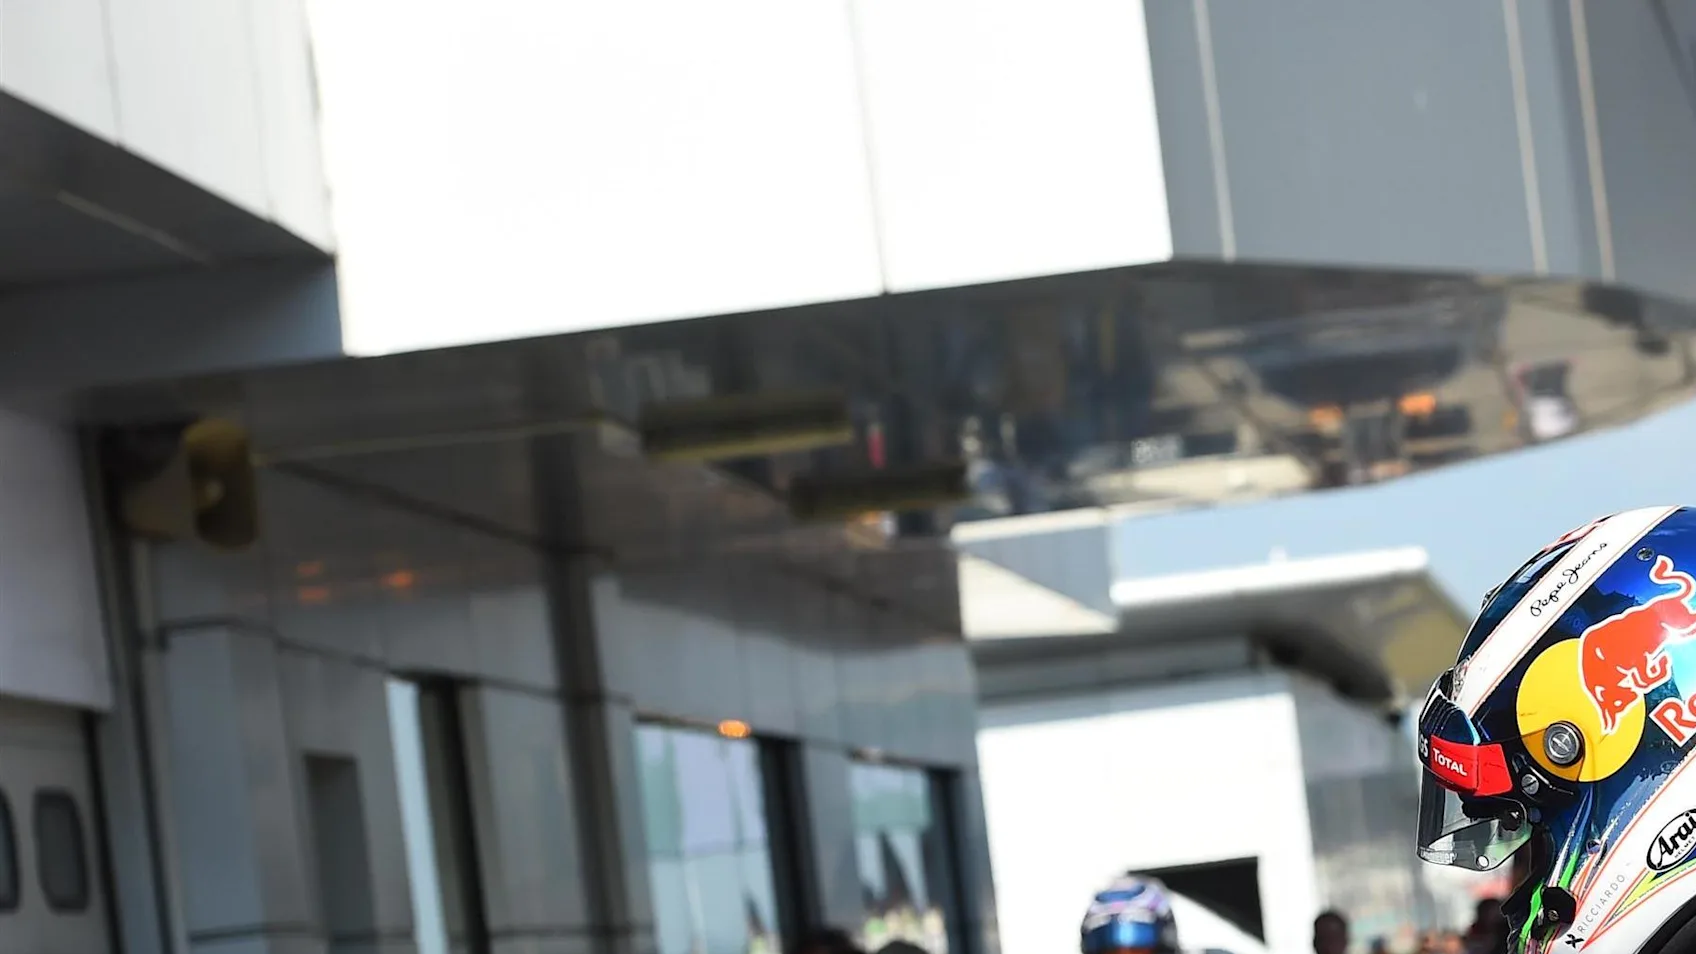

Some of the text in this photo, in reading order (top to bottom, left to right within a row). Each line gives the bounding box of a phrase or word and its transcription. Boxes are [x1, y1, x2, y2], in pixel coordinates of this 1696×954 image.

[1529, 542, 1608, 617] Pepe Jeans
[1432, 747, 1468, 777] TOTAL
[1576, 873, 1626, 934] RICCIARDO
